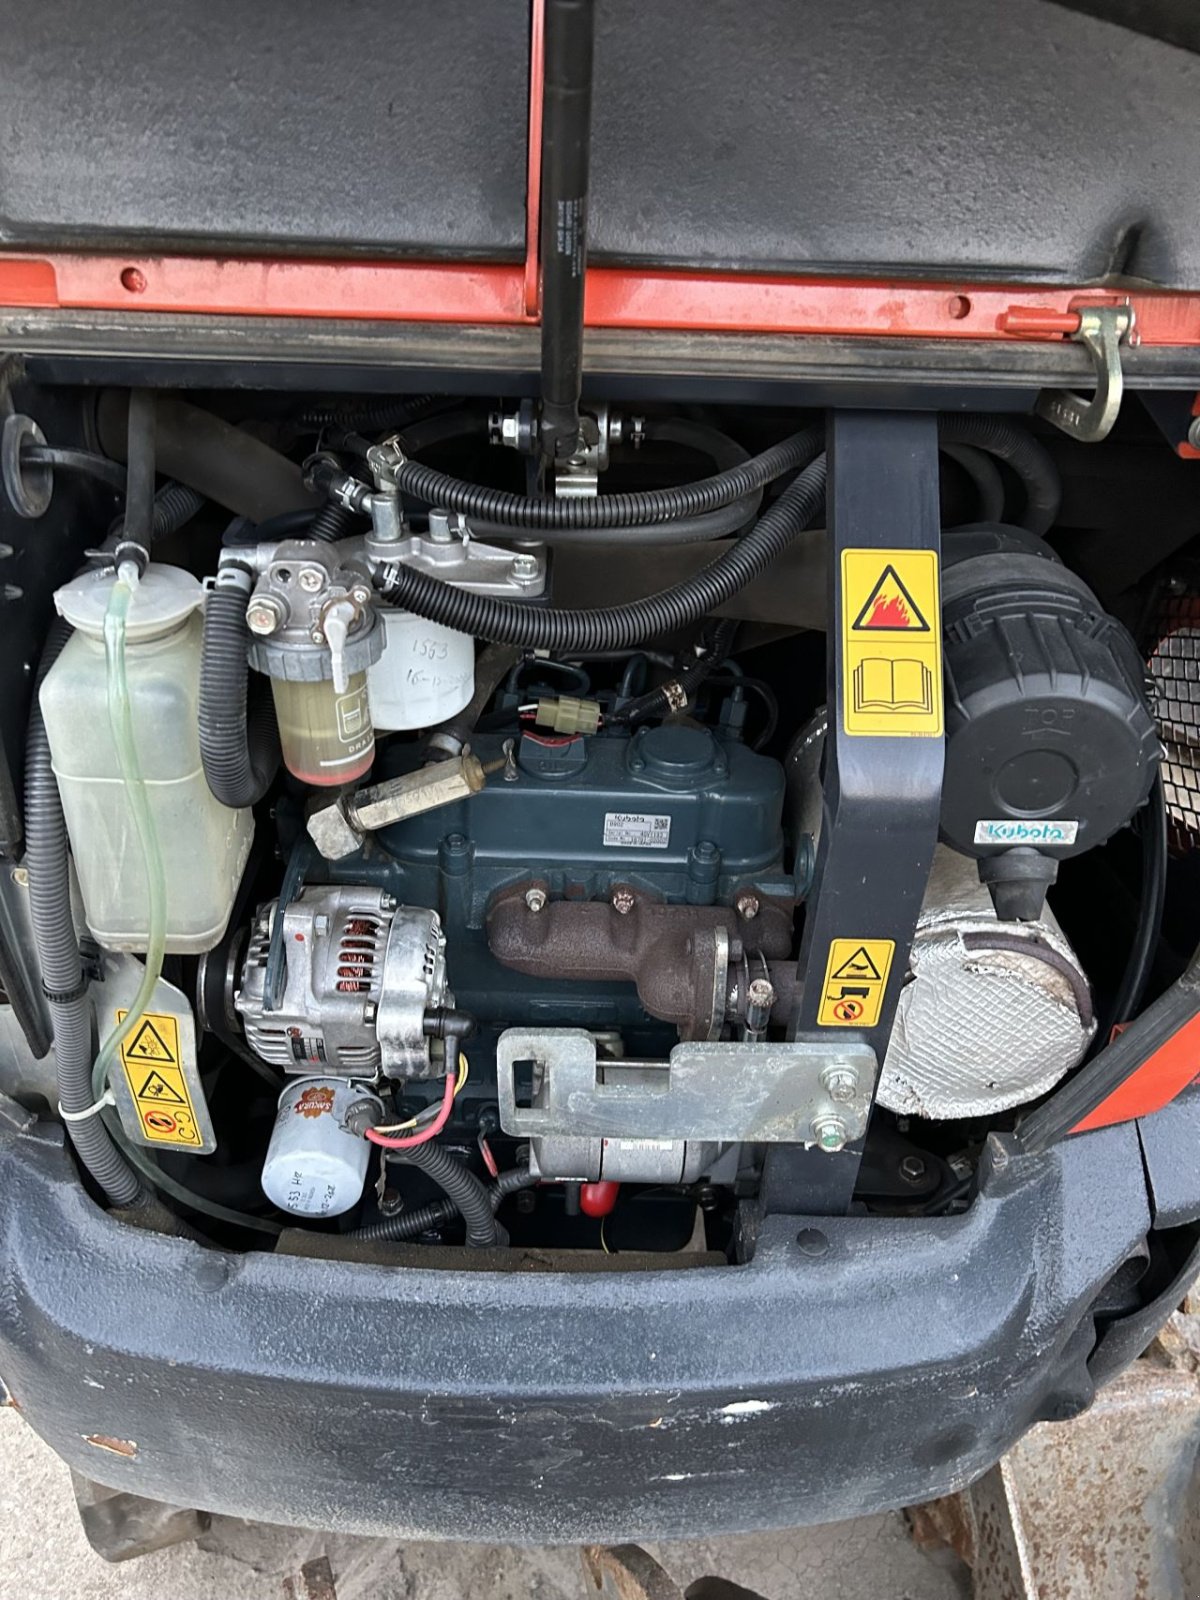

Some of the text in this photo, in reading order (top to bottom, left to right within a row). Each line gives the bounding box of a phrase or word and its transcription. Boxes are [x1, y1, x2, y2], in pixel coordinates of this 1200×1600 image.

[1024, 708, 1076, 725] TOP
[988, 824, 1064, 840] Kubota
[298, 1101, 332, 1111] SAKURA
